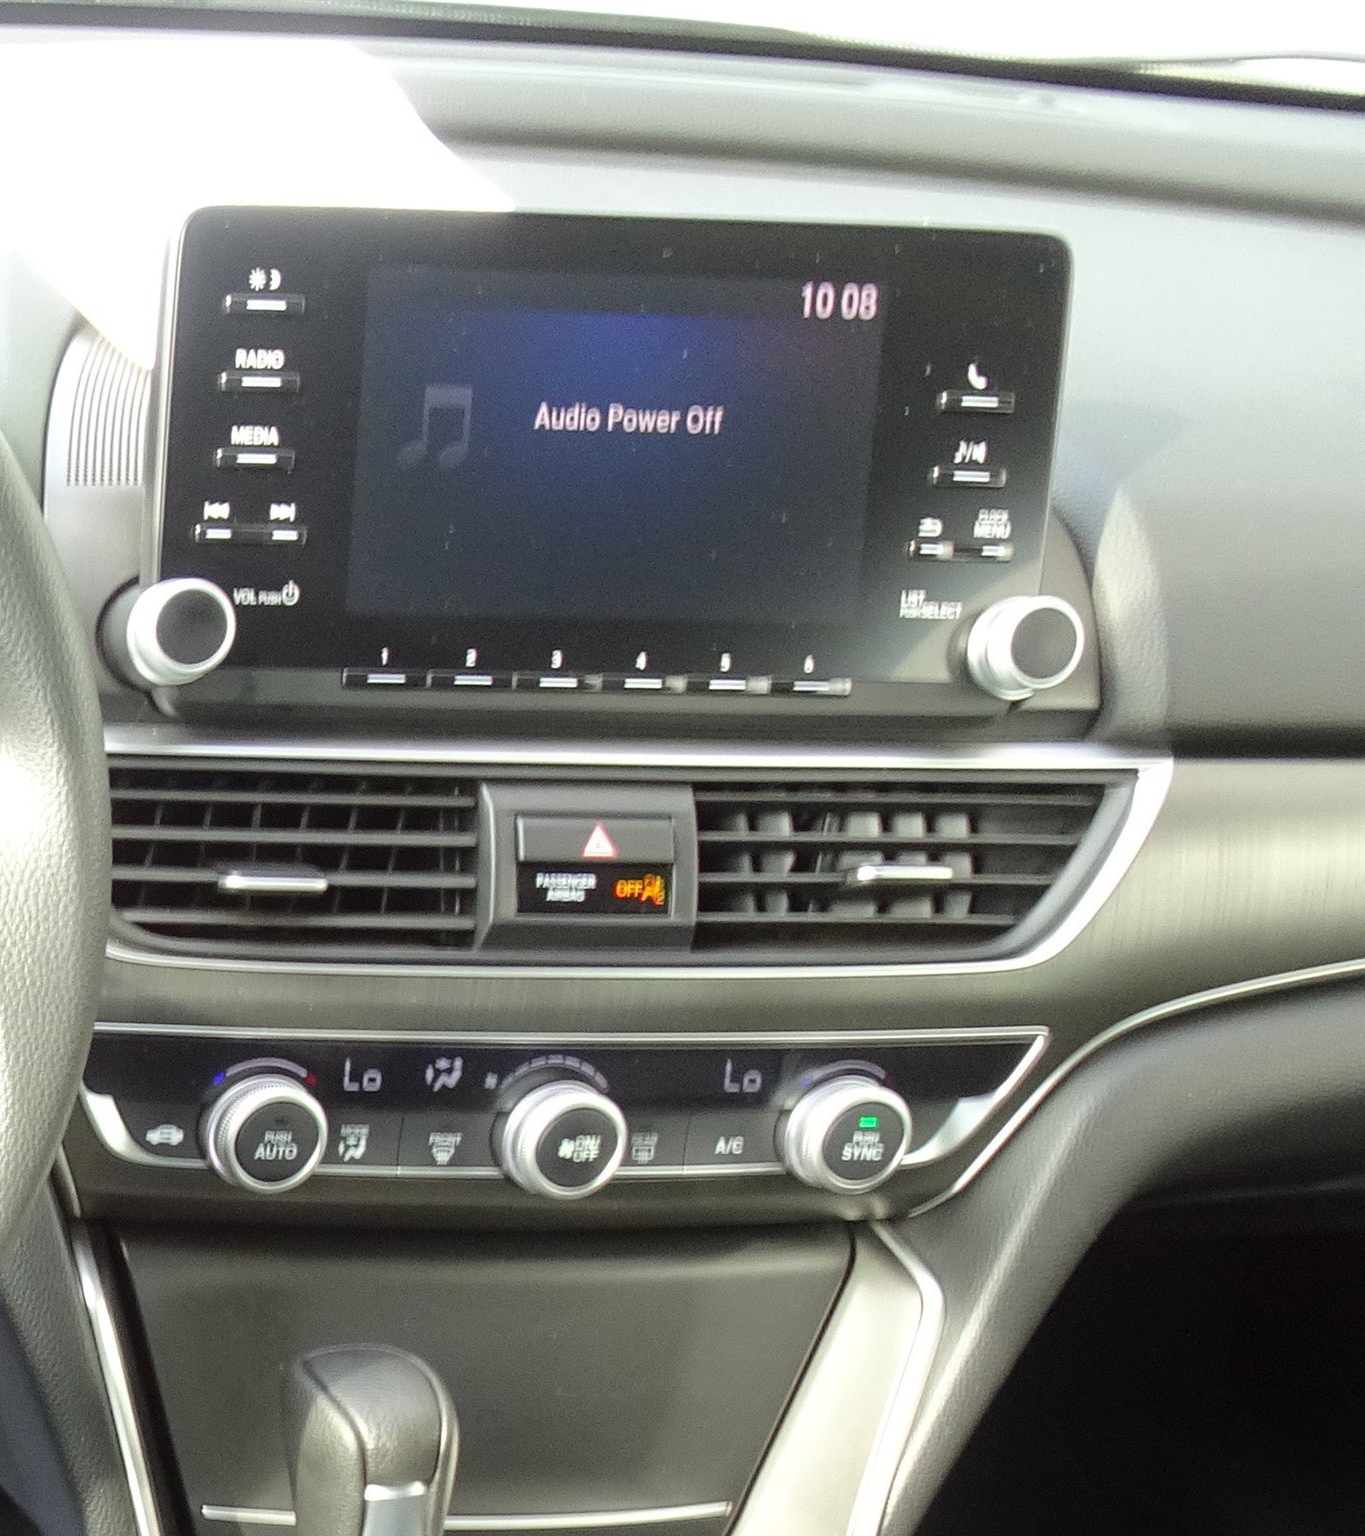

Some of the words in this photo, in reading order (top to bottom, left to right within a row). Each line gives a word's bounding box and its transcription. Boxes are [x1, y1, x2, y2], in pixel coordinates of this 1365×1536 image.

[235, 348, 285, 370] RADIO
[533, 401, 600, 431] Audio
[607, 402, 681, 434] Power
[686, 405, 724, 435] Off
[231, 425, 279, 446] MEDIA
[973, 520, 1011, 539] MENU
[233, 587, 257, 606] VOL
[921, 601, 963, 620] SELECT
[381, 647, 389, 665] 1
[465, 648, 477, 667] 2
[551, 649, 563, 669] 3
[536, 872, 596, 889] PASSENGER
[615, 880, 642, 898] OFF
[265, 1131, 294, 1145] PUSH
[715, 1136, 744, 1155] A/C
[254, 1143, 298, 1160] AUTO
[573, 1149, 599, 1163] OFF
[841, 1143, 885, 1161] SYNC
